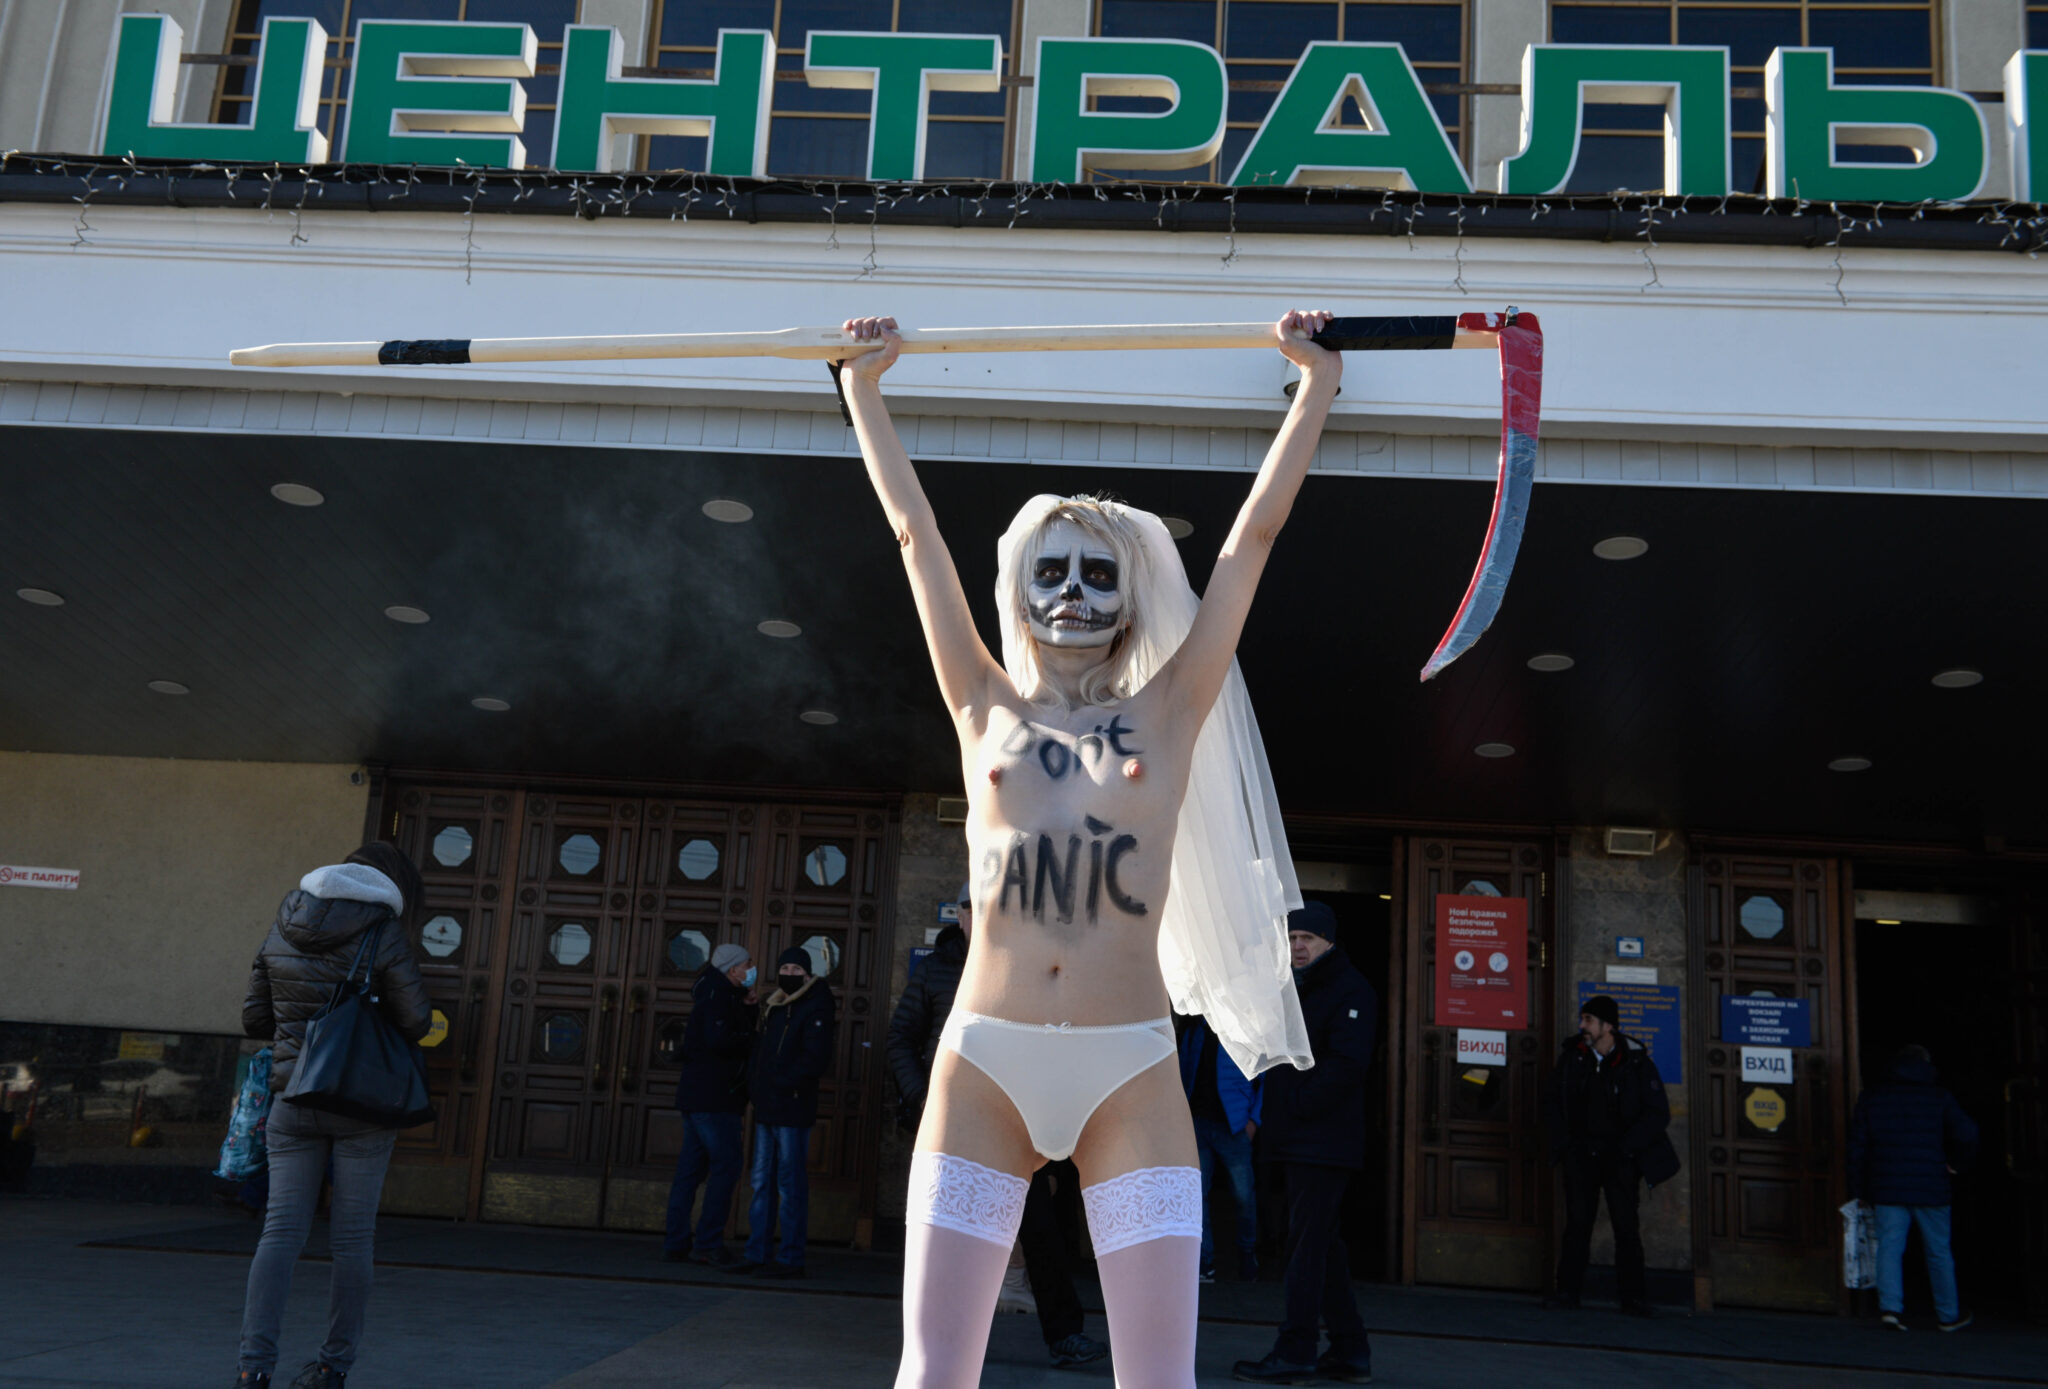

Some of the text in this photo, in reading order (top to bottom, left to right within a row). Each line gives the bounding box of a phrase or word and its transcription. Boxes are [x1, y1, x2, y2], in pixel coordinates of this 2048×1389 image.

[102, 12, 2048, 204] ЦЕНТРАЛЬ
[14, 871, 79, 883] НЕ ПАЛИТИ
[1459, 1040, 1505, 1056] ВИХІД
[1745, 1056, 1786, 1074] ВХІД
